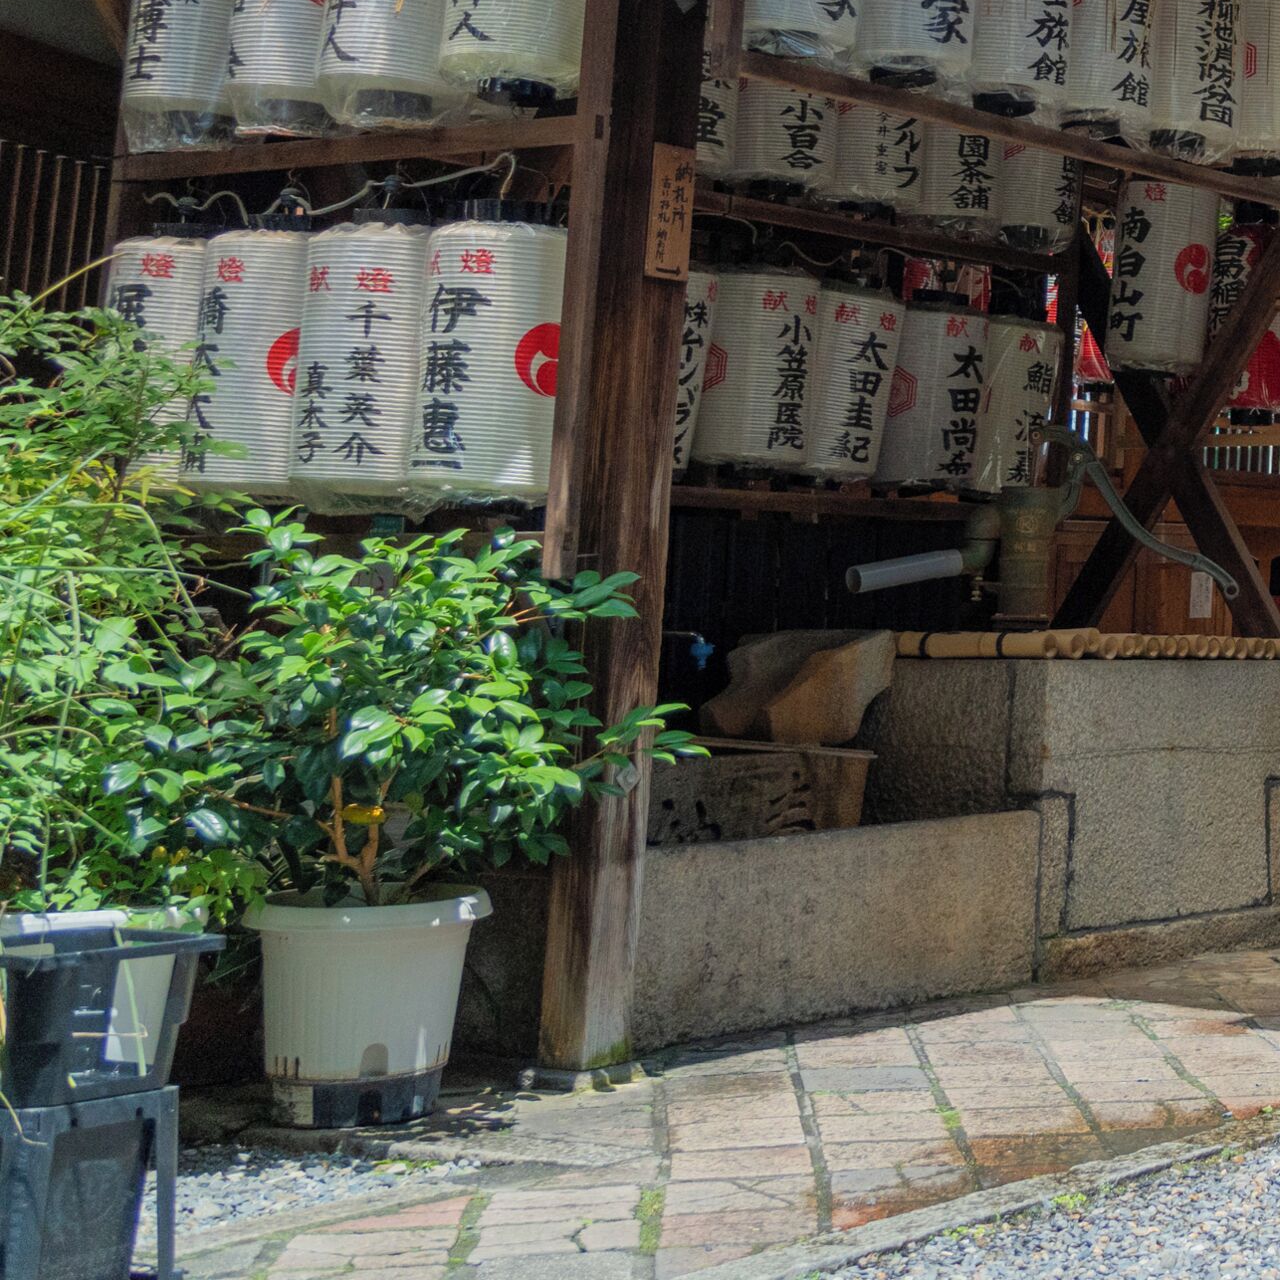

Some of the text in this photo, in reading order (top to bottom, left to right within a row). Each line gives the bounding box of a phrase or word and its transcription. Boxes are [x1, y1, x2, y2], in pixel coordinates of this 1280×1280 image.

[310, 266, 396, 293] 献燈
[1110, 206, 1151, 342] 南白山町
[333, 300, 392, 466] 千葉英介
[767, 315, 812, 450] 小笠原医院
